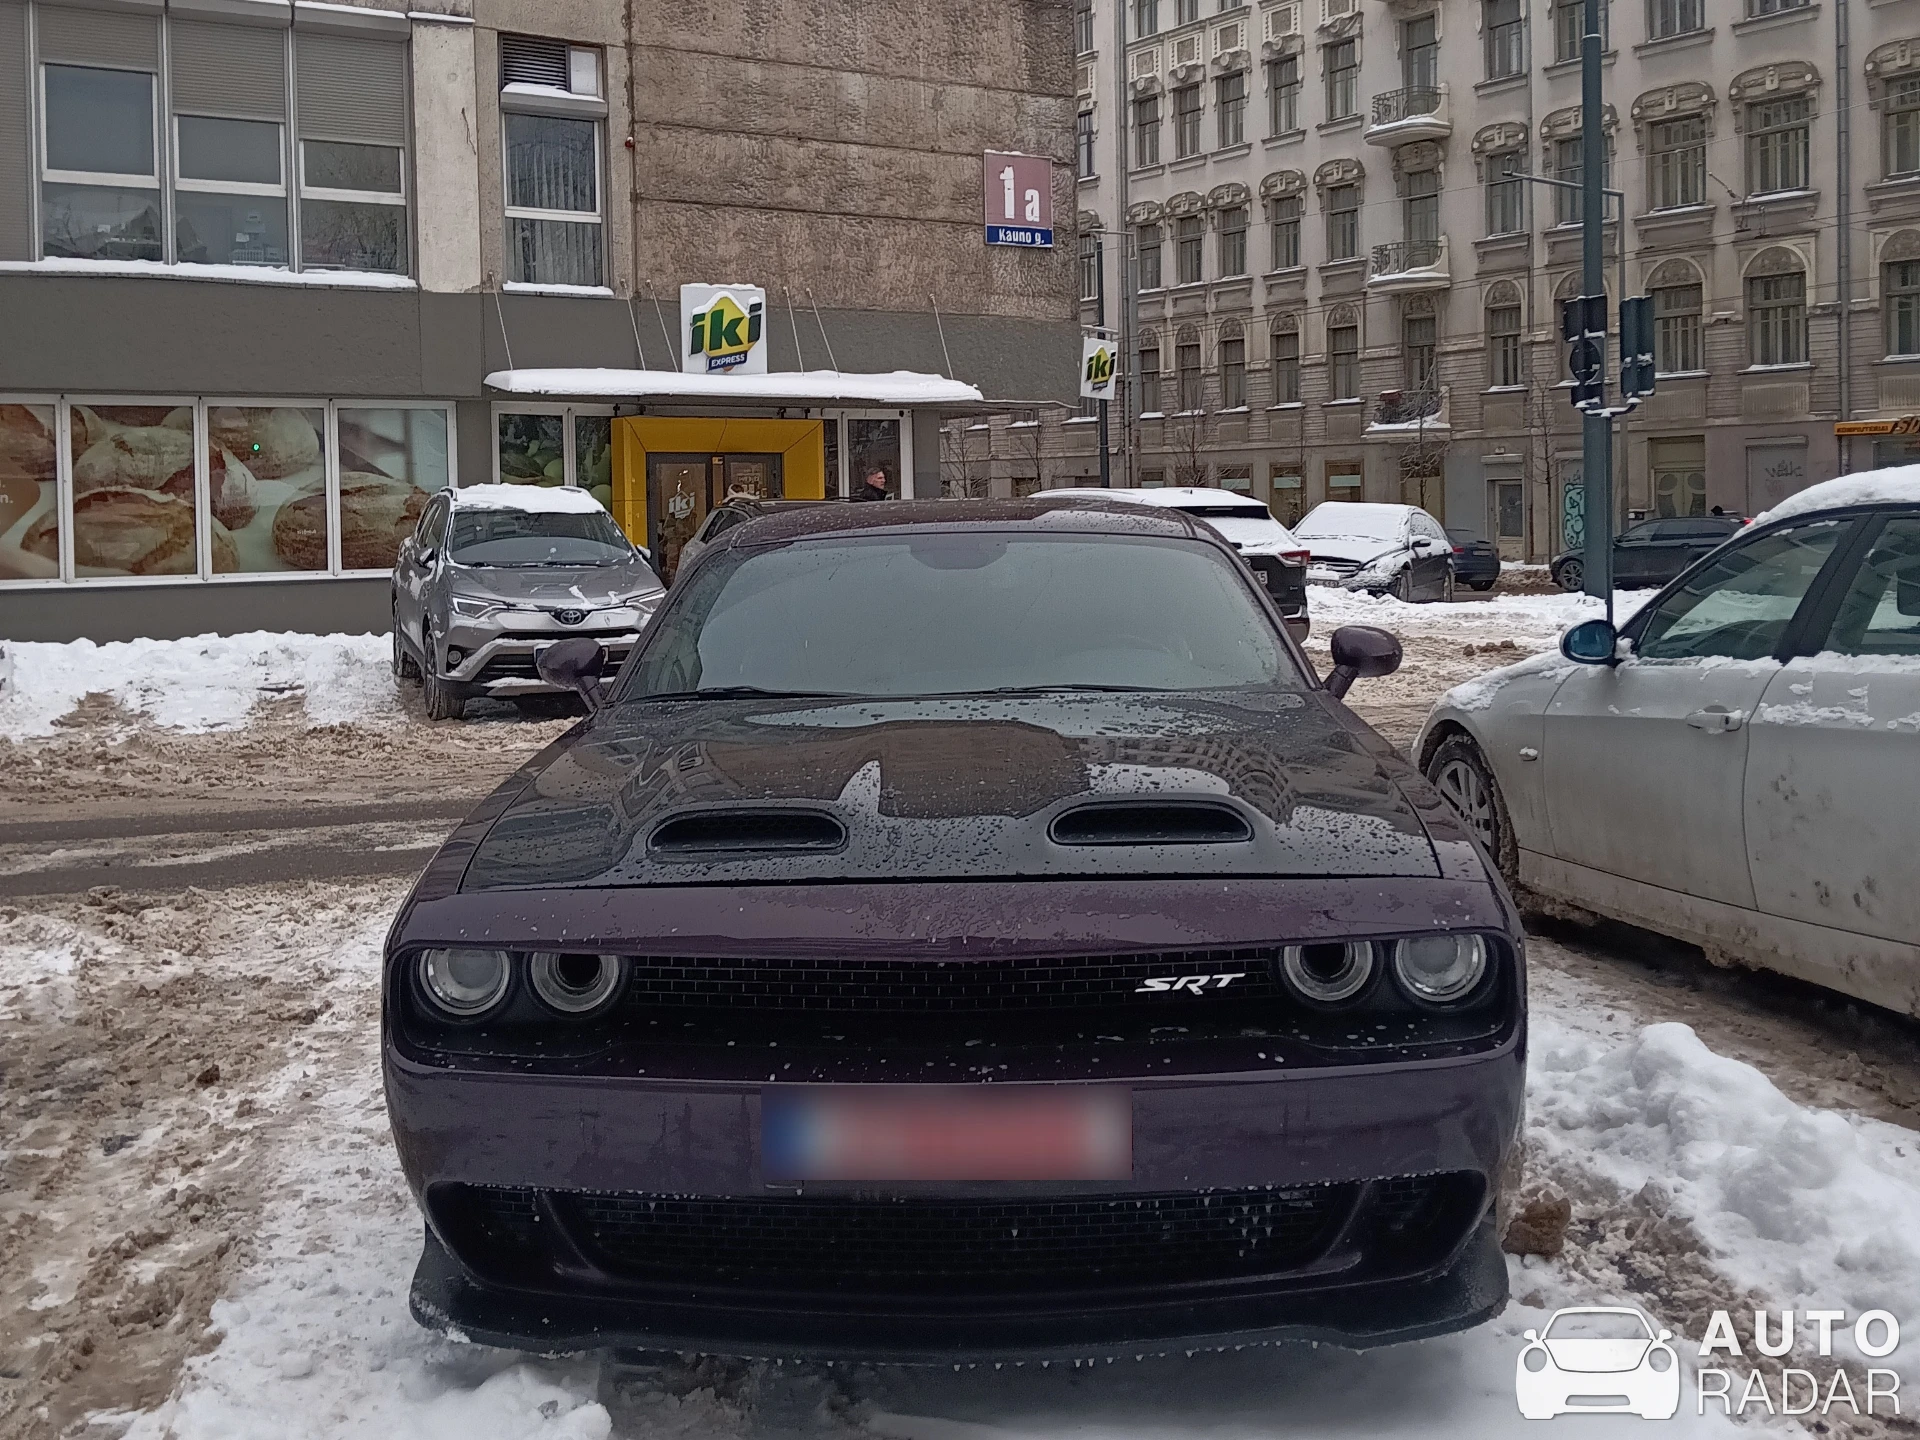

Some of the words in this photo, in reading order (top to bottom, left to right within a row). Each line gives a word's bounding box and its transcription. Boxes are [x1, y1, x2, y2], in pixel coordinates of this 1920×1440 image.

[998, 228, 1032, 243] Kauno
[1035, 232, 1045, 245] g.
[691, 302, 762, 355] iki
[711, 354, 745, 367] EXPRESS
[1086, 351, 1116, 380] iki
[669, 492, 695, 514] iki
[1135, 973, 1246, 995] SRT
